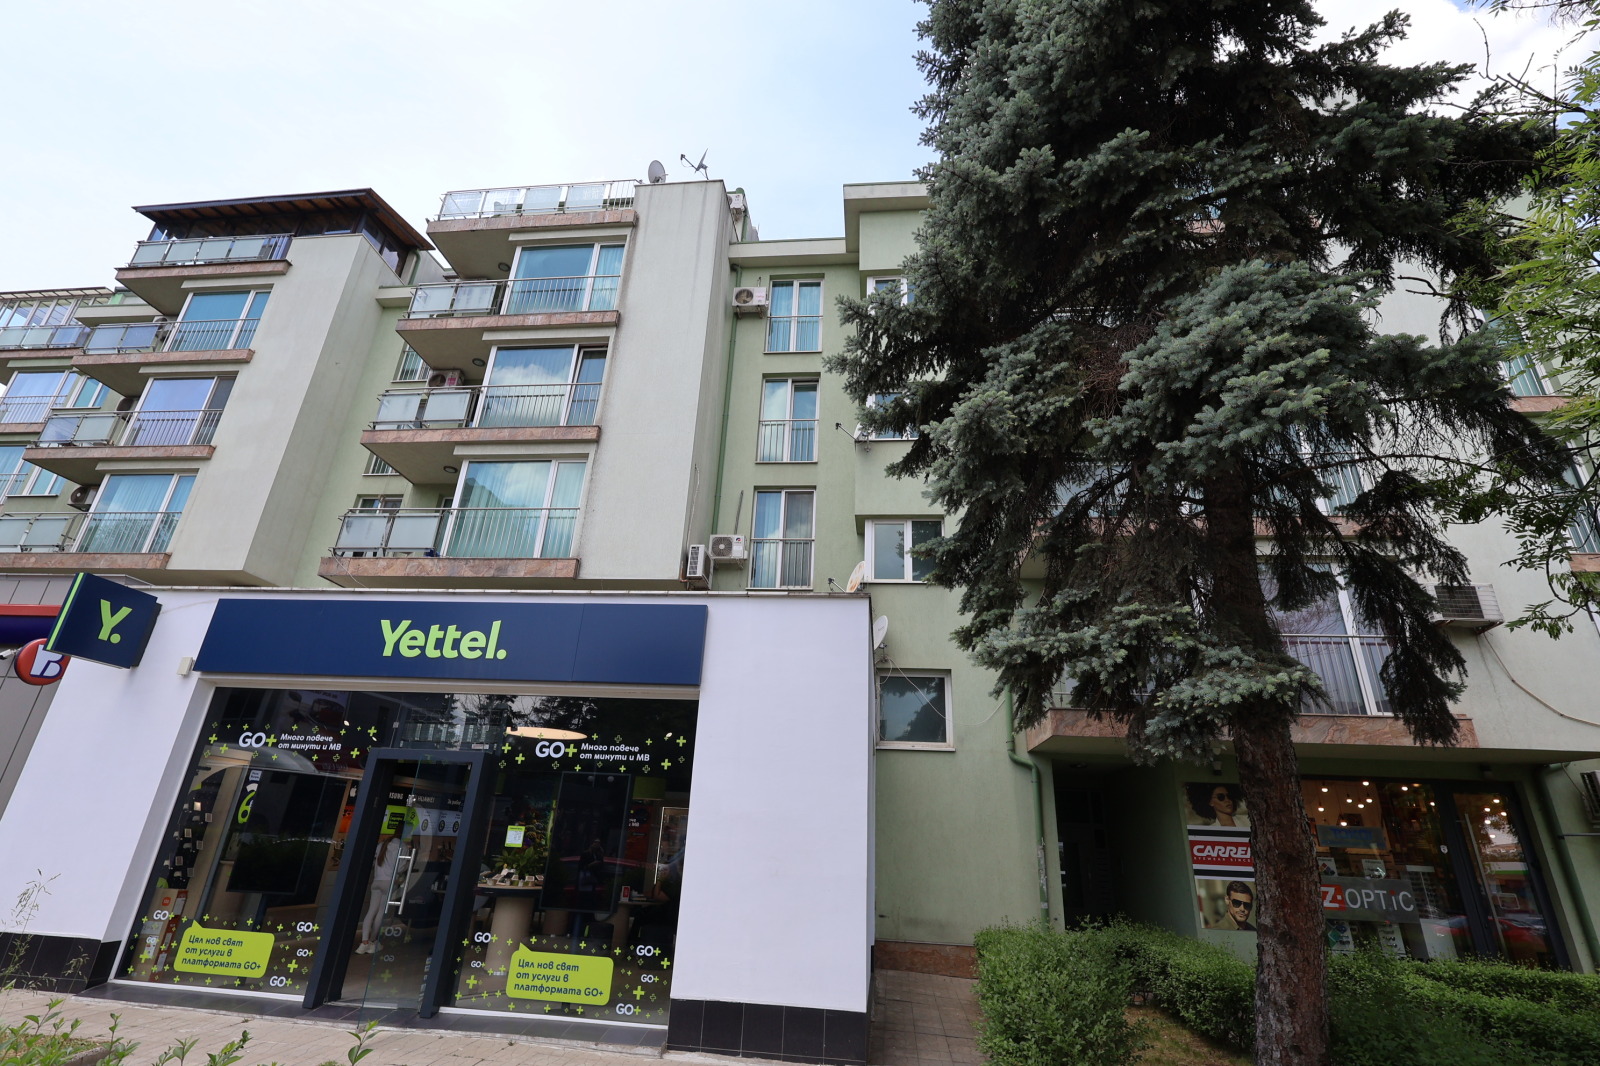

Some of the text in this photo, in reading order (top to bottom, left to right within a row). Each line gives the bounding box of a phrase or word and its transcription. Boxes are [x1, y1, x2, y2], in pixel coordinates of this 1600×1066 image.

[98, 599, 133, 644] Y.
[380, 619, 507, 660] Yettel.
[238, 731, 277, 748] GO+
[280, 733, 334, 743] Много повече
[291, 743, 321, 751] минути
[535, 741, 578, 759] GO+
[580, 742, 640, 752] Много повече
[579, 752, 593, 760] от
[593, 753, 627, 762] минути
[1193, 845, 1251, 858] CARRE
[153, 910, 175, 921] GO+
[296, 921, 319, 933] GO+
[188, 934, 244, 947] Цял нов свят
[474, 932, 498, 943] GO+
[198, 947, 225, 958] услуги
[226, 949, 233, 957] в
[297, 948, 314, 957] GO+
[636, 945, 661, 957] GO+
[181, 956, 262, 970] платформата GO+
[470, 960, 486, 968] GO+
[517, 958, 580, 972] Цял нов свят
[269, 975, 293, 987] GO+
[515, 971, 569, 983] от услуги в
[640, 974, 660, 983] GO+
[513, 982, 604, 997] платформата GO+
[616, 1003, 642, 1015] GO+
